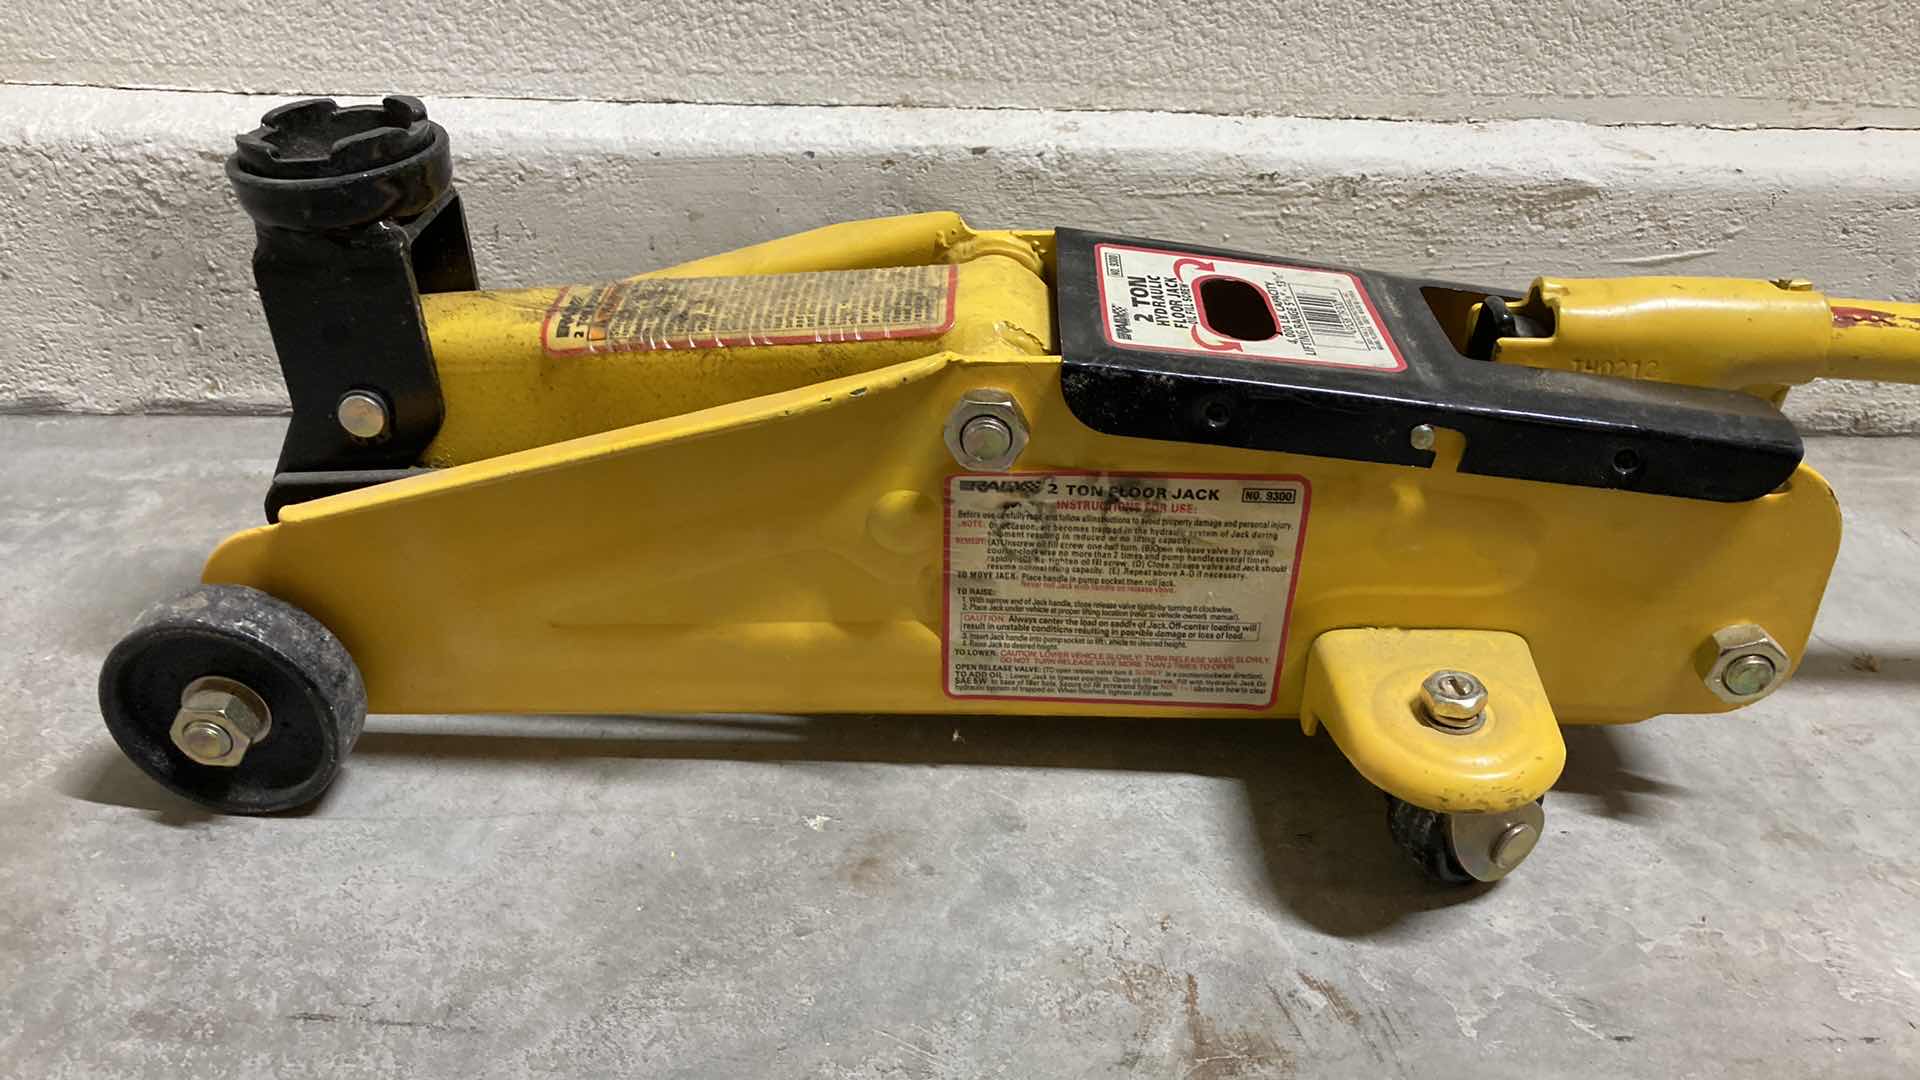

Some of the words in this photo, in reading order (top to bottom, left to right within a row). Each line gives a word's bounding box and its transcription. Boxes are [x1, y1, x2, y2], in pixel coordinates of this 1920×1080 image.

[1127, 275, 1150, 307] TON
[1164, 276, 1182, 298] JACK
[1180, 283, 1193, 302] SCREW
[1264, 281, 1285, 312] CAPACITY
[1147, 275, 1170, 327] HYDRAULIC
[1184, 303, 1196, 314] FILL
[1134, 313, 1155, 322] 2
[1169, 299, 1189, 329] FLOOR
[1286, 306, 1304, 330] RANGE
[1295, 330, 1317, 355] LIFTING
[1047, 483, 1058, 495] 2
[1065, 484, 1103, 496] TON
[1108, 485, 1168, 498] FLOOR
[1171, 487, 1220, 500] JACK
[1265, 492, 1293, 501] 9300
[1170, 503, 1198, 513] USE:
[1223, 519, 1238, 527] and
[1238, 520, 1269, 530] personal
[1250, 531, 1279, 540] during
[963, 614, 1006, 622] CAUTION:
[1008, 616, 1037, 625] Always
[1079, 618, 1097, 626] load
[1168, 622, 1210, 630] Off-center
[1210, 623, 1241, 633] loading
[1240, 624, 1257, 632] will
[1031, 625, 1073, 633] conditions
[1153, 630, 1187, 638] damage
